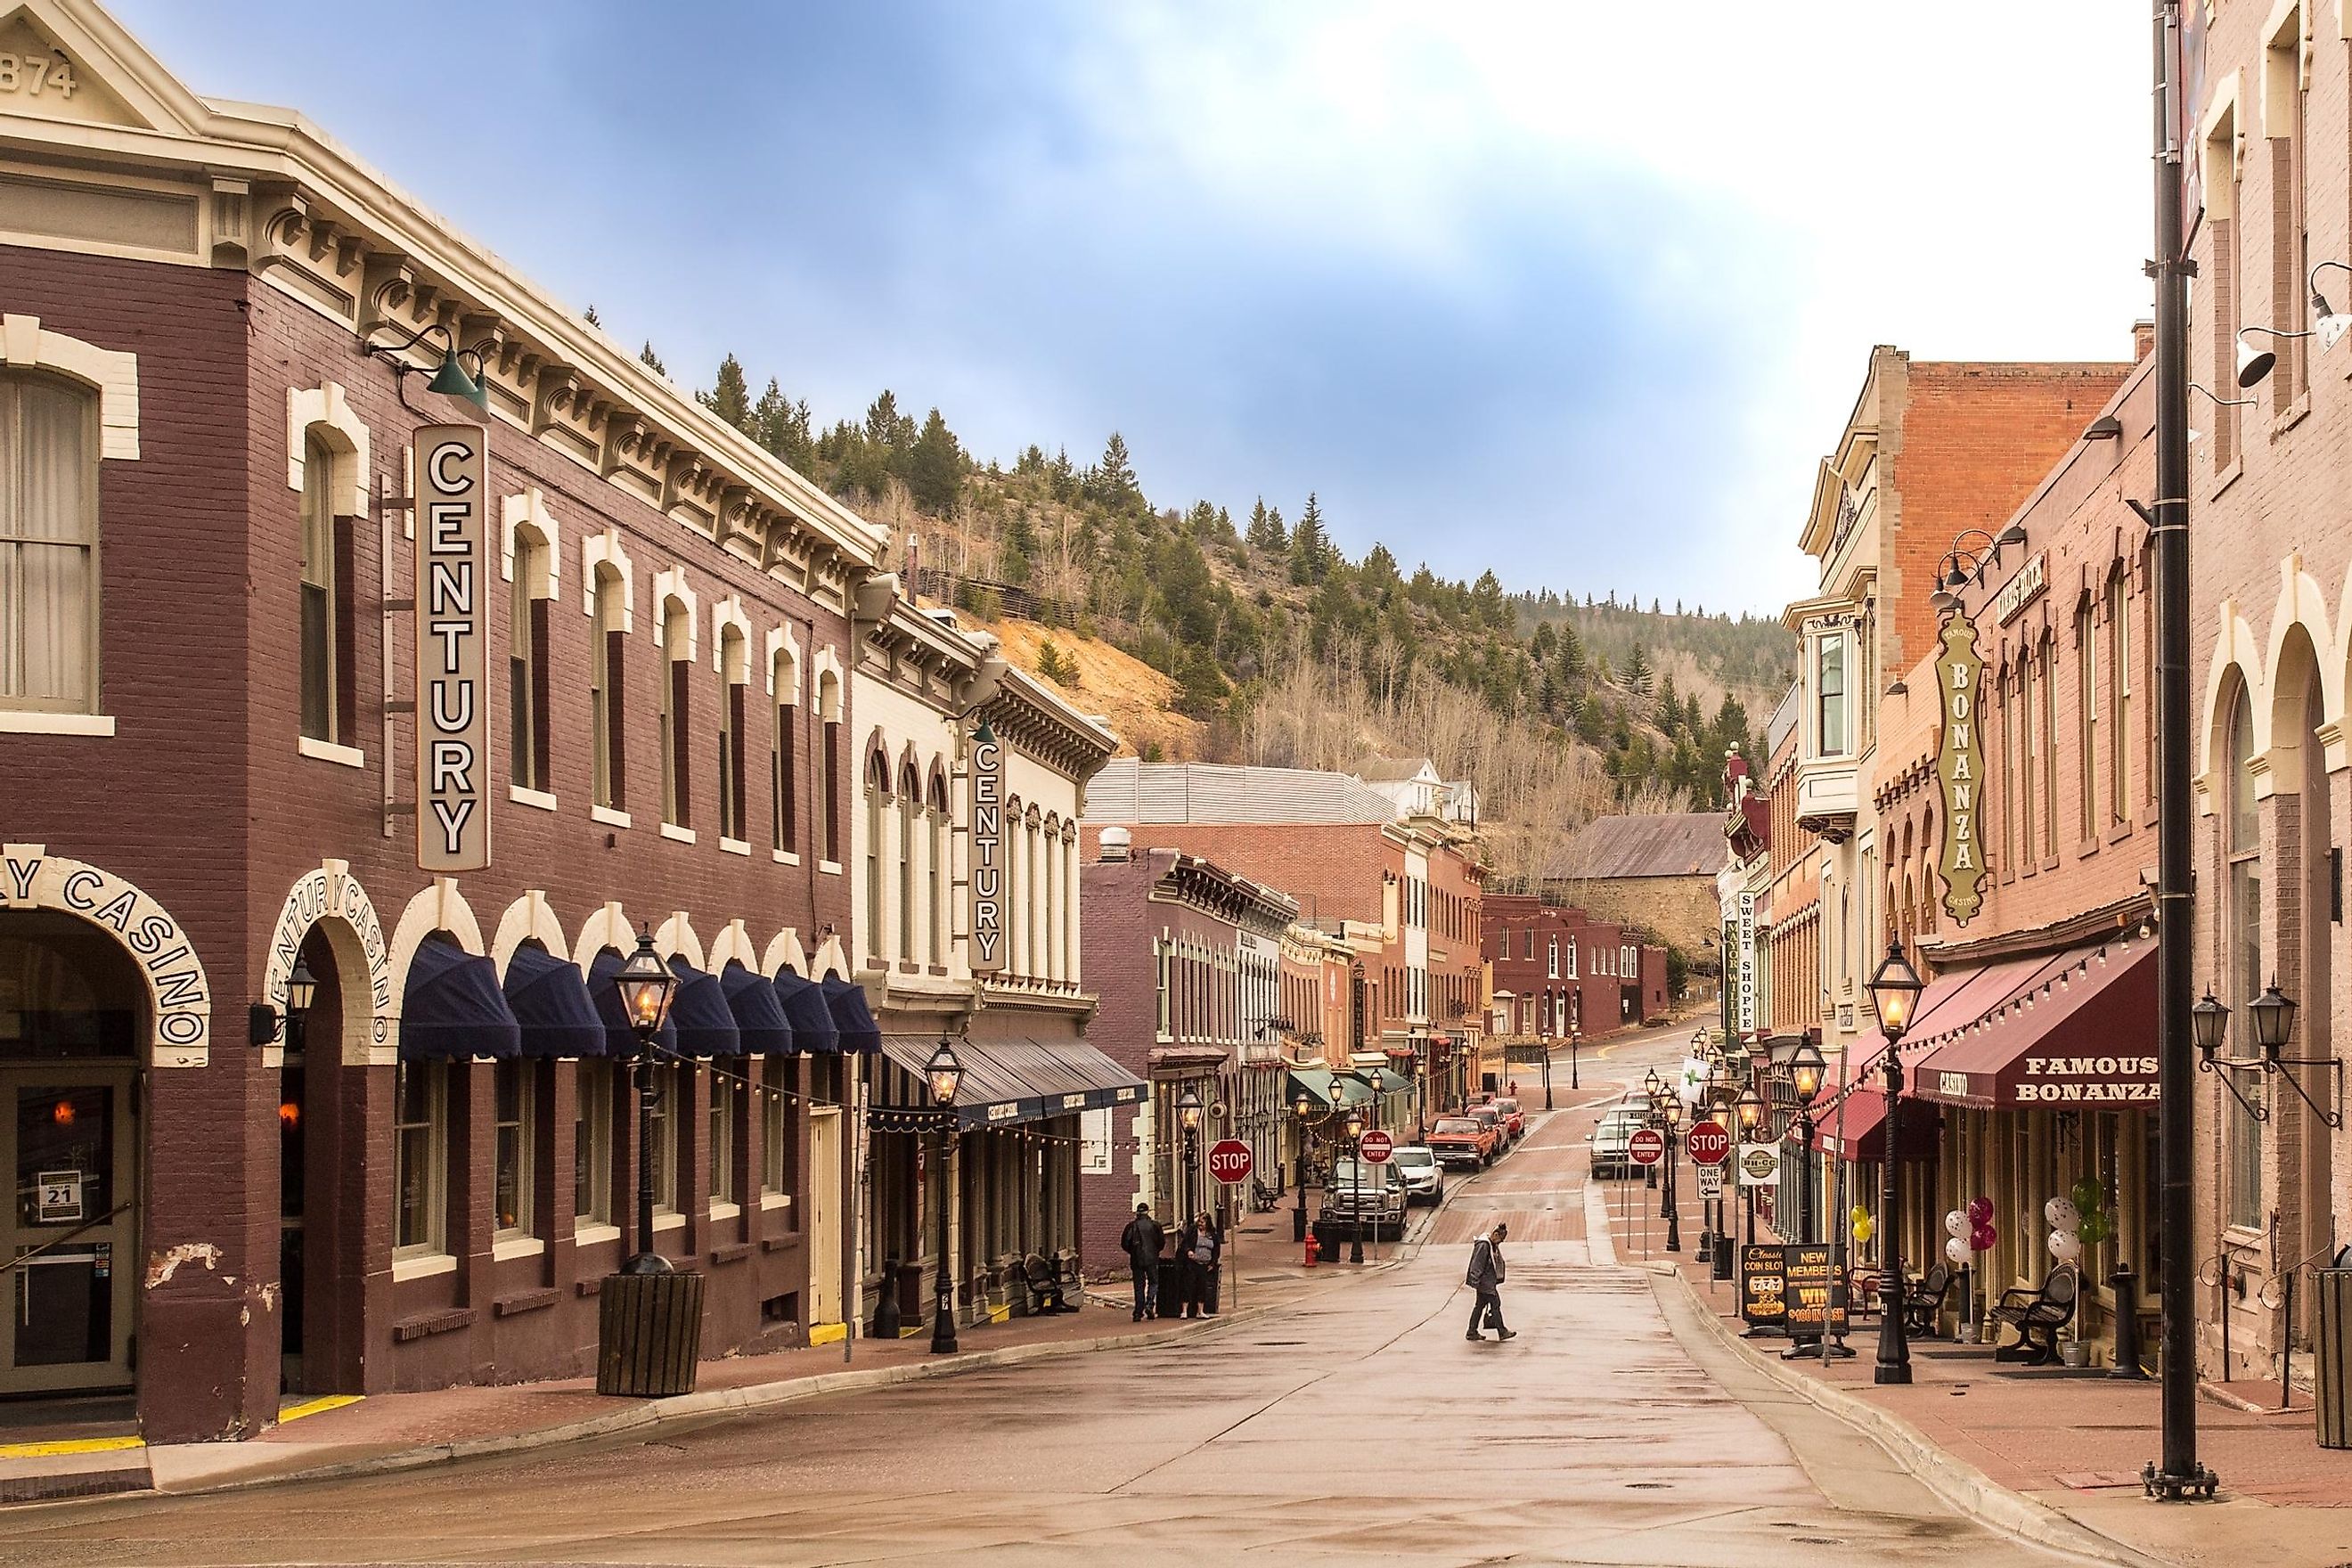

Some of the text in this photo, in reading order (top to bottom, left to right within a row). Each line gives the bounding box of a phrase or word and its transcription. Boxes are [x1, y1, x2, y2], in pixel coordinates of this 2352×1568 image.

[1944, 628, 1974, 640] FAMOUS
[428, 441, 478, 853] CENTURY
[1951, 663, 1973, 870] BONANZA
[975, 742, 1000, 961] CENTURY
[1948, 894, 1978, 906] CASINO
[0, 858, 204, 1044] Y CASINO
[1727, 923, 1738, 969] MAYOR
[345, 883, 390, 1043] CASINO
[1741, 894, 1752, 1028] SWEET SHOPPE
[2026, 1058, 2159, 1075] FAMOUS
[1939, 1072, 1968, 1098] CASINO
[1690, 1134, 1727, 1151] STOP
[1212, 1153, 1249, 1171] STOP
[1700, 1168, 1719, 1177] ONE
[1700, 1178, 1719, 1187] WAY
[48, 1189, 71, 1204] 21
[1744, 1262, 1763, 1271] COIN
[1801, 1253, 1826, 1263] NEW
[1787, 1265, 1842, 1278] MEMBES
[1812, 1308, 1822, 1322] IN
[1821, 1307, 1845, 1322] CSH
